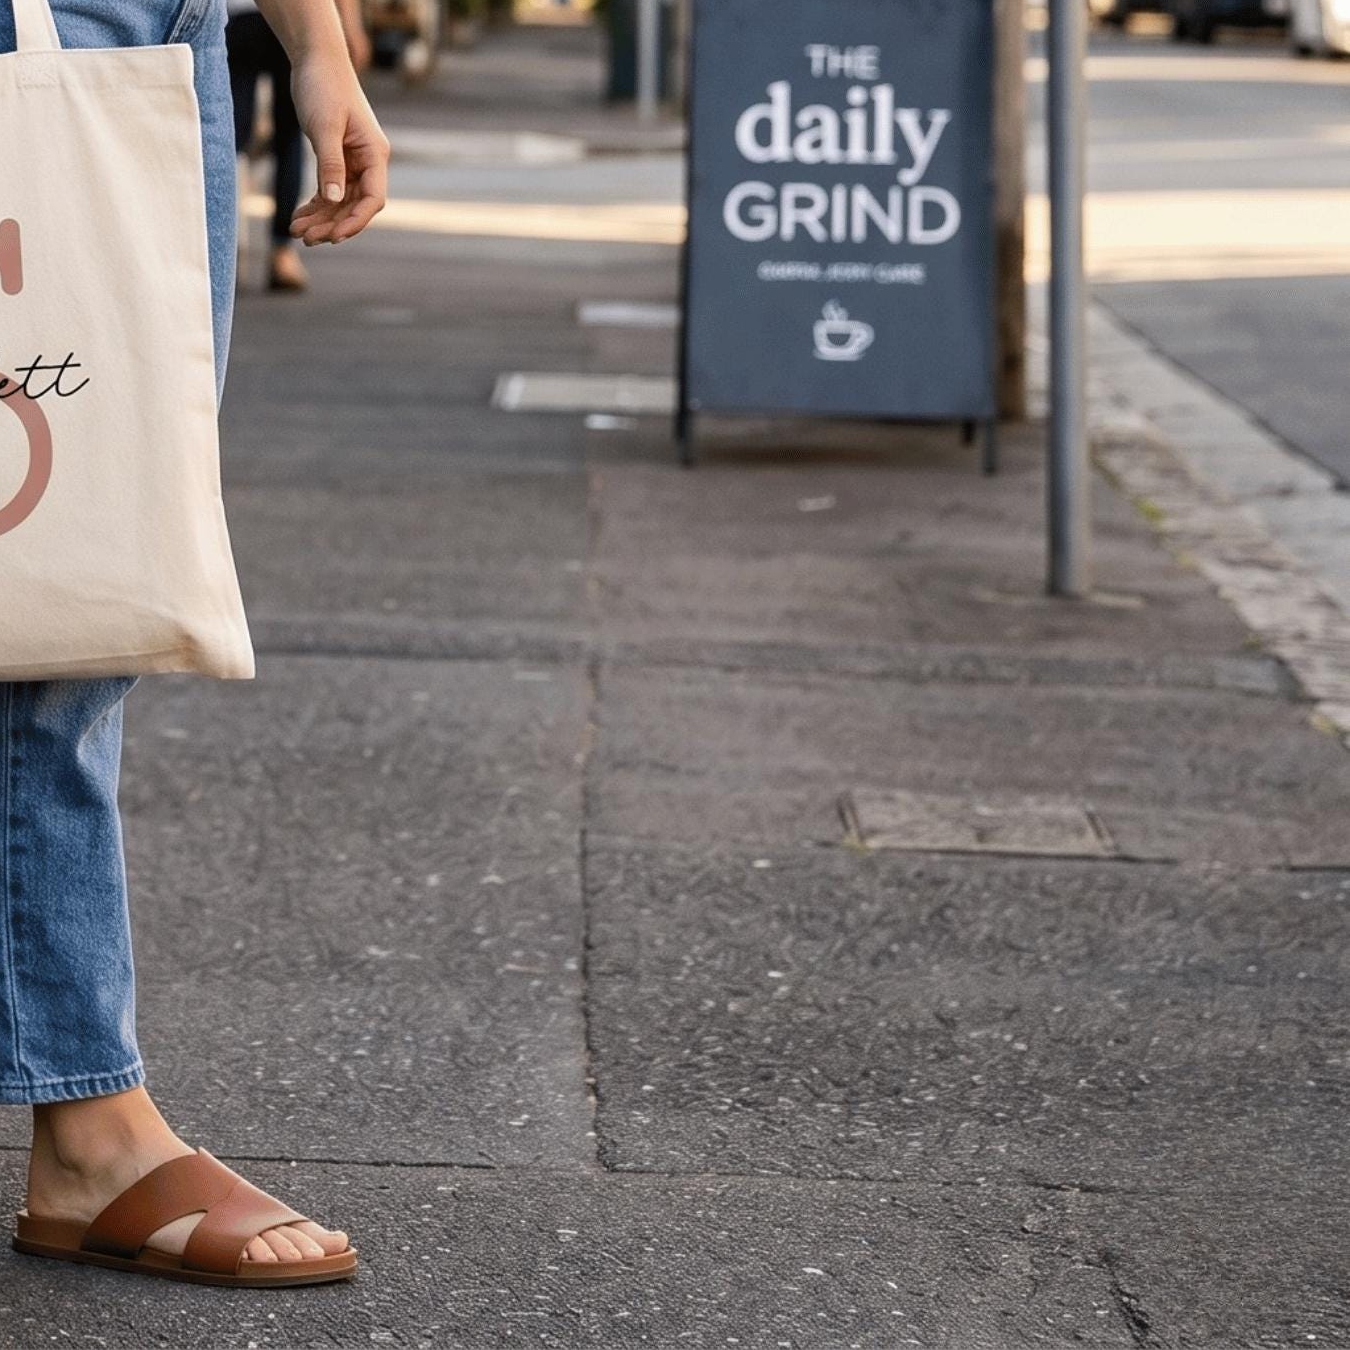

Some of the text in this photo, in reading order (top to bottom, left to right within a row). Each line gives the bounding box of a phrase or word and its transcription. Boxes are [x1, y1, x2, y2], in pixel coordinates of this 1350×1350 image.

[805, 43, 880, 81] THE
[734, 80, 951, 186] daily
[722, 180, 962, 245] GRIND
